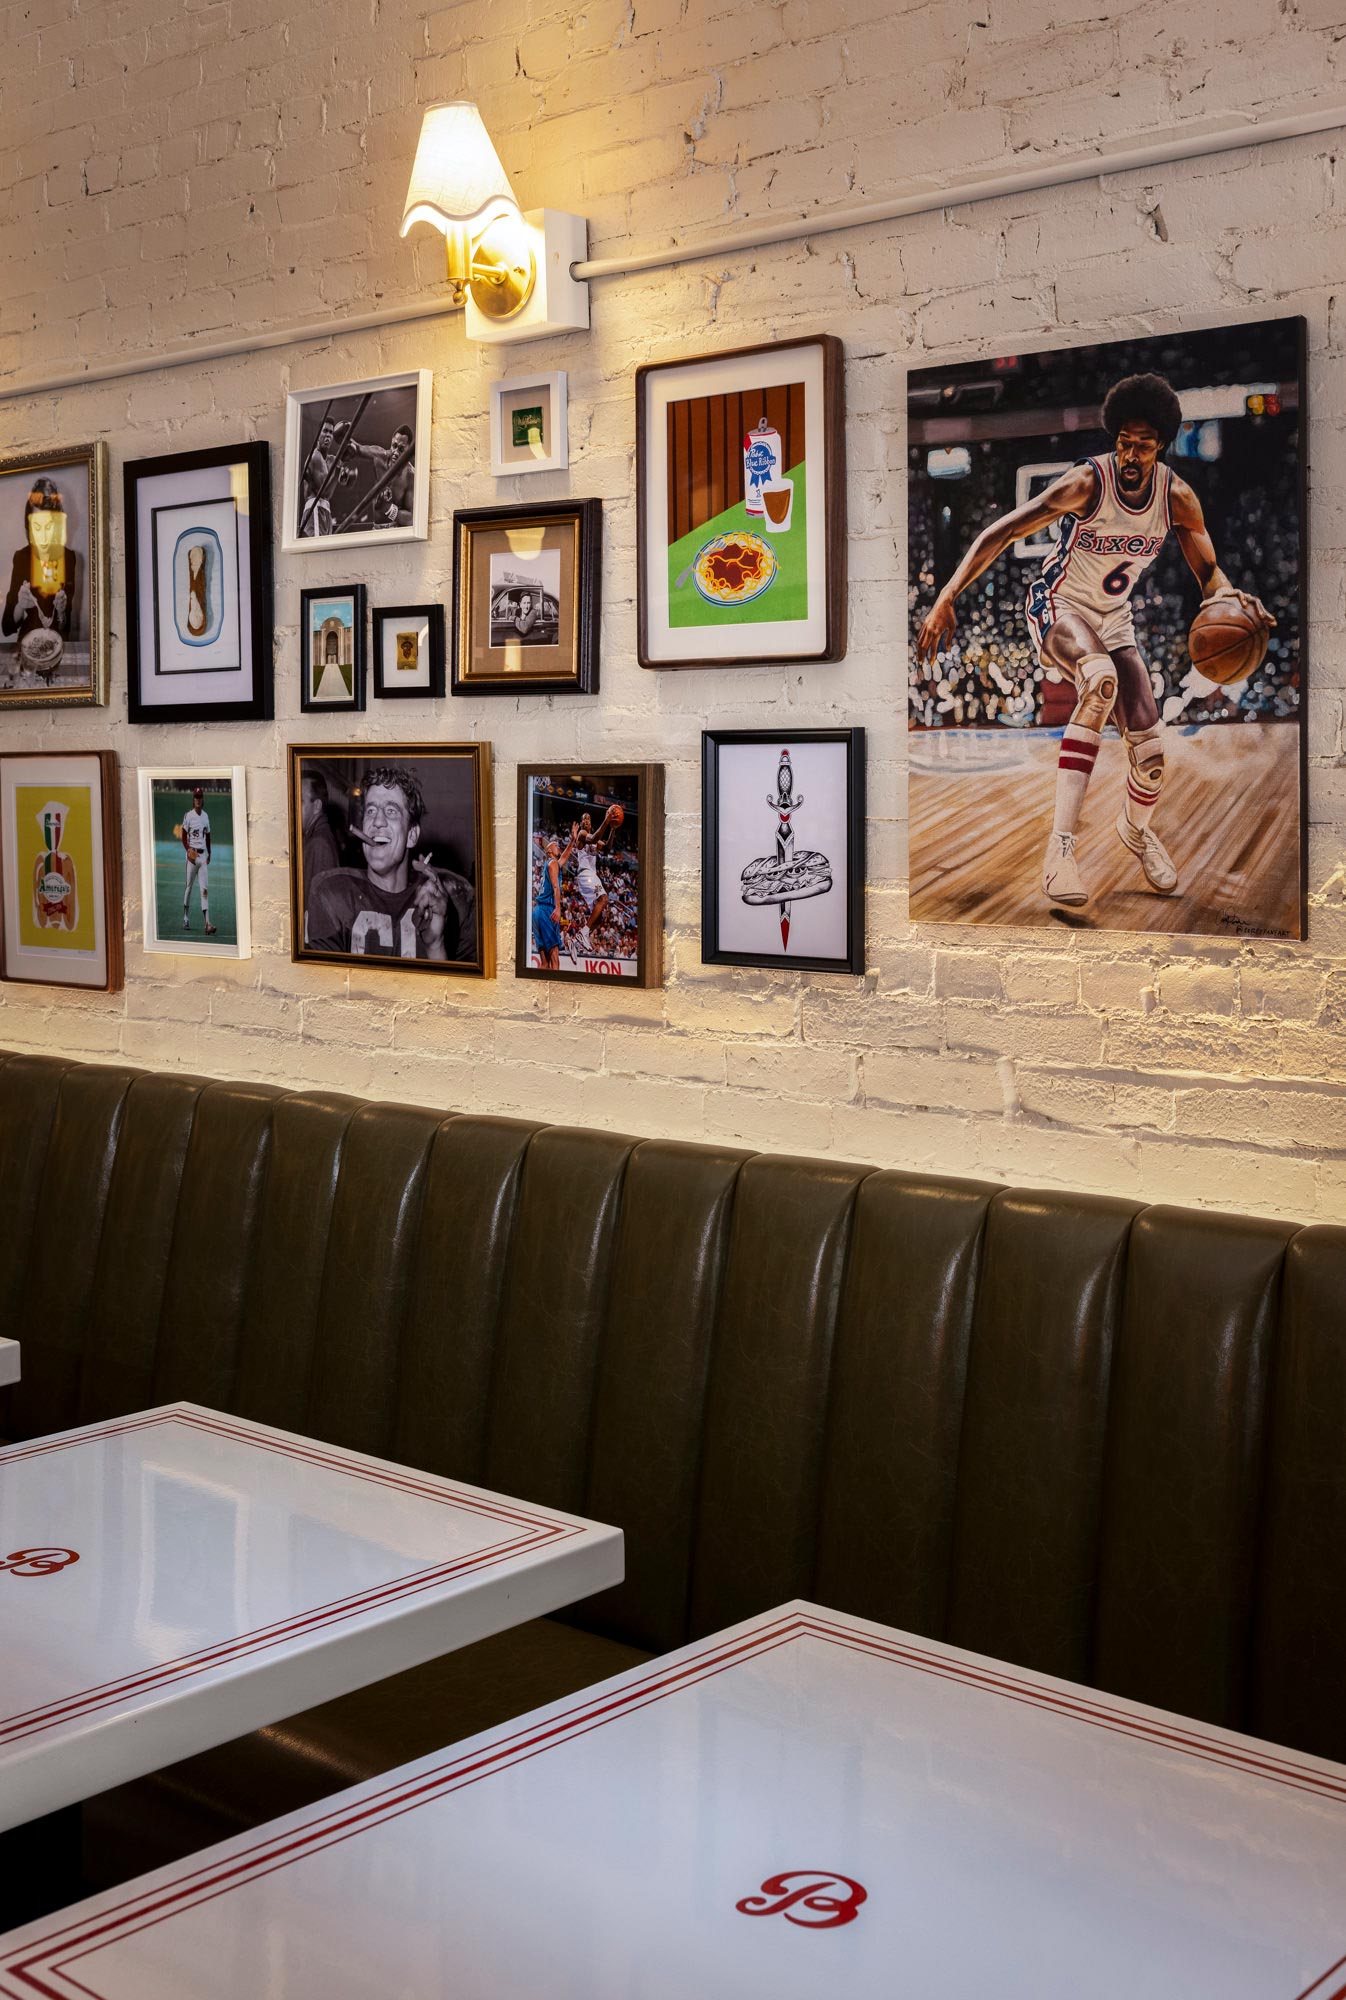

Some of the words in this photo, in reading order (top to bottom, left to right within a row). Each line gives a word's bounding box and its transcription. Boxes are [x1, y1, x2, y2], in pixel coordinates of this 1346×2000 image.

[746, 458, 759, 468] Blue
[759, 455, 776, 467] Ribbon
[1076, 529, 1163, 556] Sixer
[1103, 561, 1134, 596] 6
[585, 960, 622, 976] IKON
[0, 1547, 80, 1577] B
[735, 1870, 868, 1929] B
